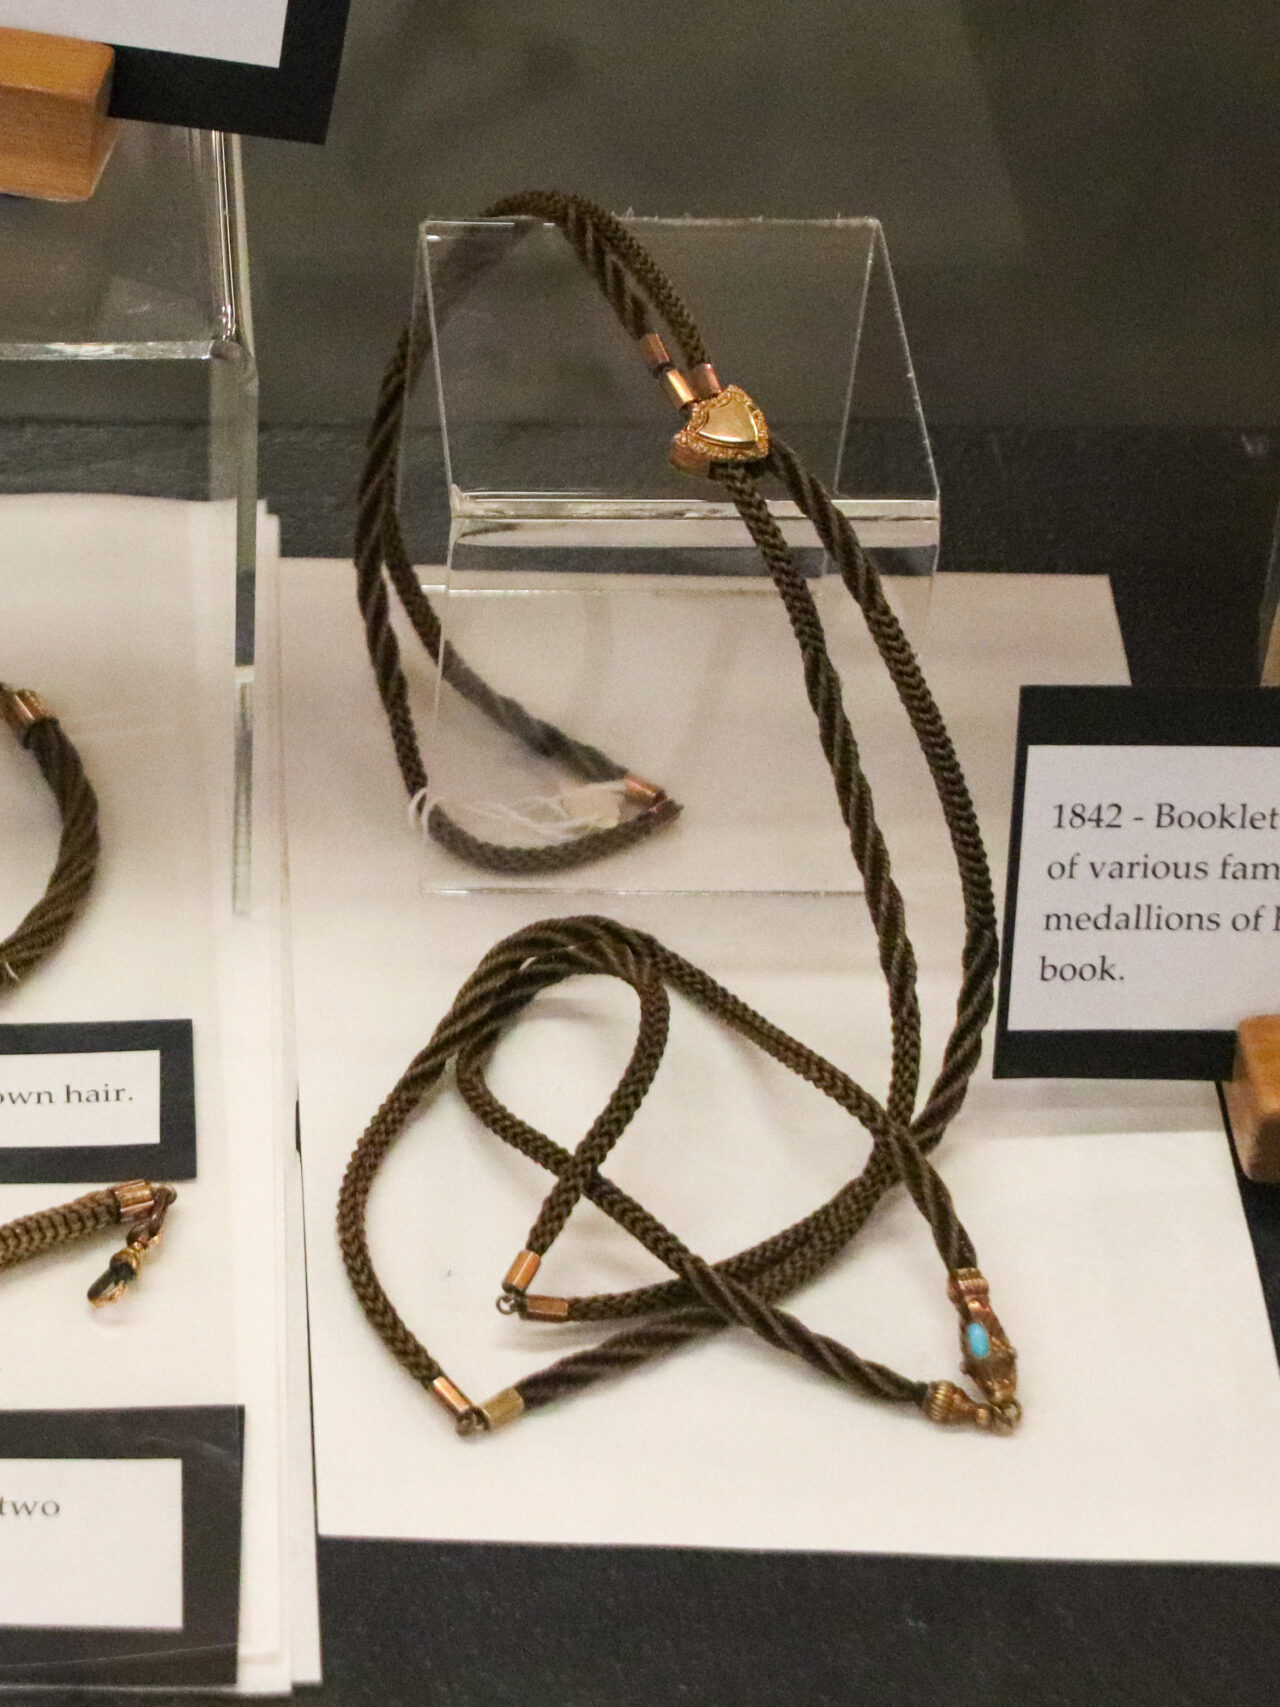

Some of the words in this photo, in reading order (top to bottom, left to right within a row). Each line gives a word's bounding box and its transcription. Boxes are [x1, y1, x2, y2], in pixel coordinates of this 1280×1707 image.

[1054, 803, 1122, 829] 1842
[1156, 802, 1280, 831] Booklet
[1046, 853, 1081, 881] of
[1089, 853, 1209, 881] various
[1219, 852, 1280, 881] fam
[1043, 904, 1220, 932] medallions
[1231, 904, 1267, 933] of
[1039, 955, 1125, 983] book.
[65, 1083, 134, 1104] hair.
